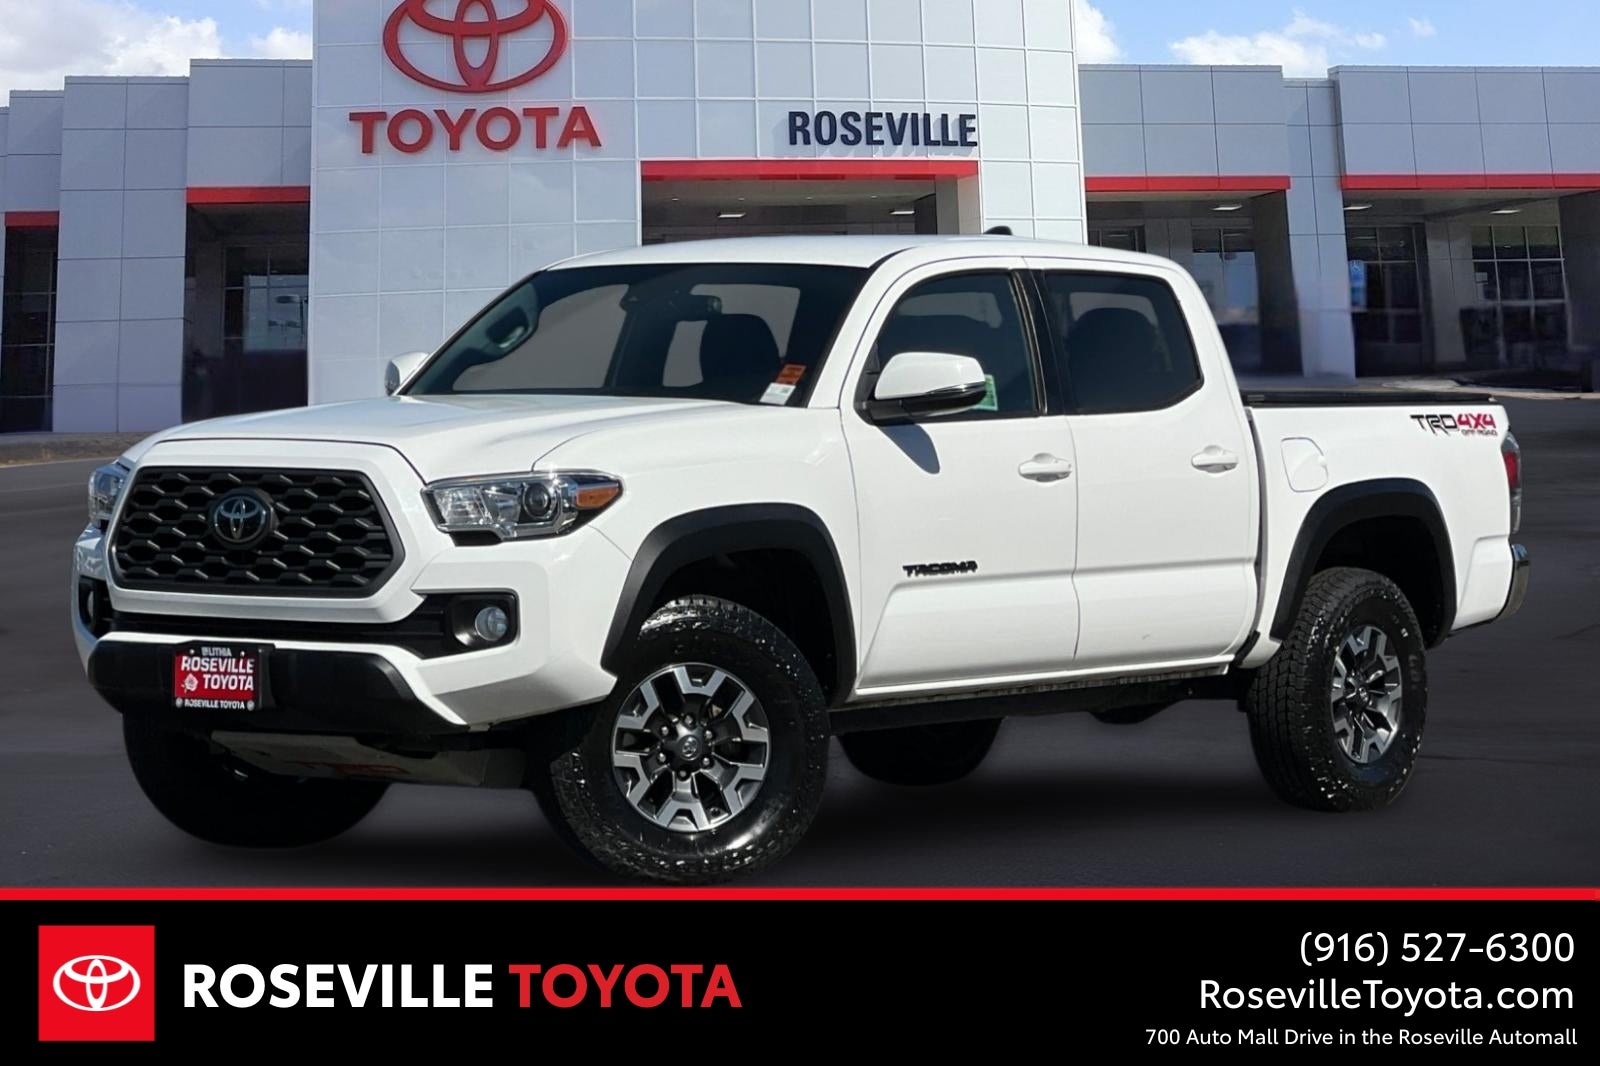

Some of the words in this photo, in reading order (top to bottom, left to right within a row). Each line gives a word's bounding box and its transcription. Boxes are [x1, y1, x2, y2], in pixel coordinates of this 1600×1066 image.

[350, 106, 602, 154] TOYOTA
[788, 110, 978, 148] ROSEVILLE
[902, 560, 978, 577] TACOMA
[208, 647, 232, 657] LITHIA
[181, 656, 254, 673] ROSEVILLE
[203, 674, 254, 691] TOYOTA
[184, 699, 219, 708] ROSEVILLE
[220, 700, 245, 709] TOYOTA
